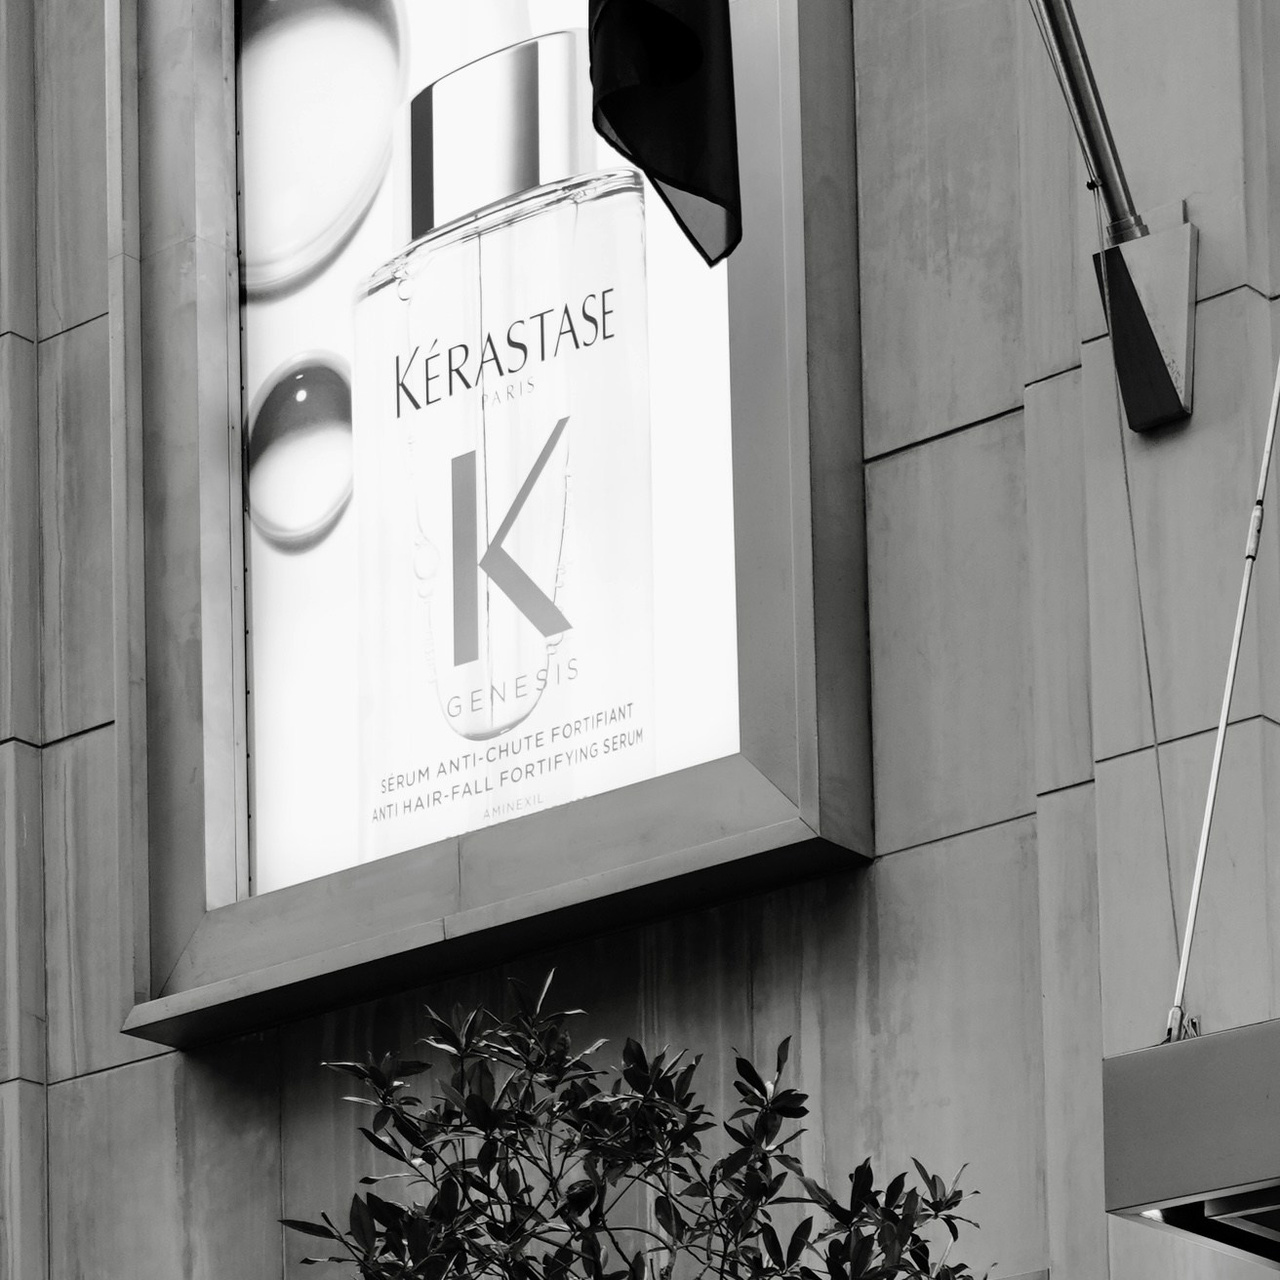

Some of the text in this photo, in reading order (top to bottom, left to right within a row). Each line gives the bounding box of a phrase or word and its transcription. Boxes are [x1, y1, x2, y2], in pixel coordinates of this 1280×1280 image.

[396, 288, 615, 418] KÉRASTASE
[447, 658, 579, 718] GENESIS
[381, 702, 634, 794] SÉRUM ANTI-CHUTE FORTIFIANT
[500, 742, 599, 787] FORTIFYING
[603, 728, 644, 755] SERUM
